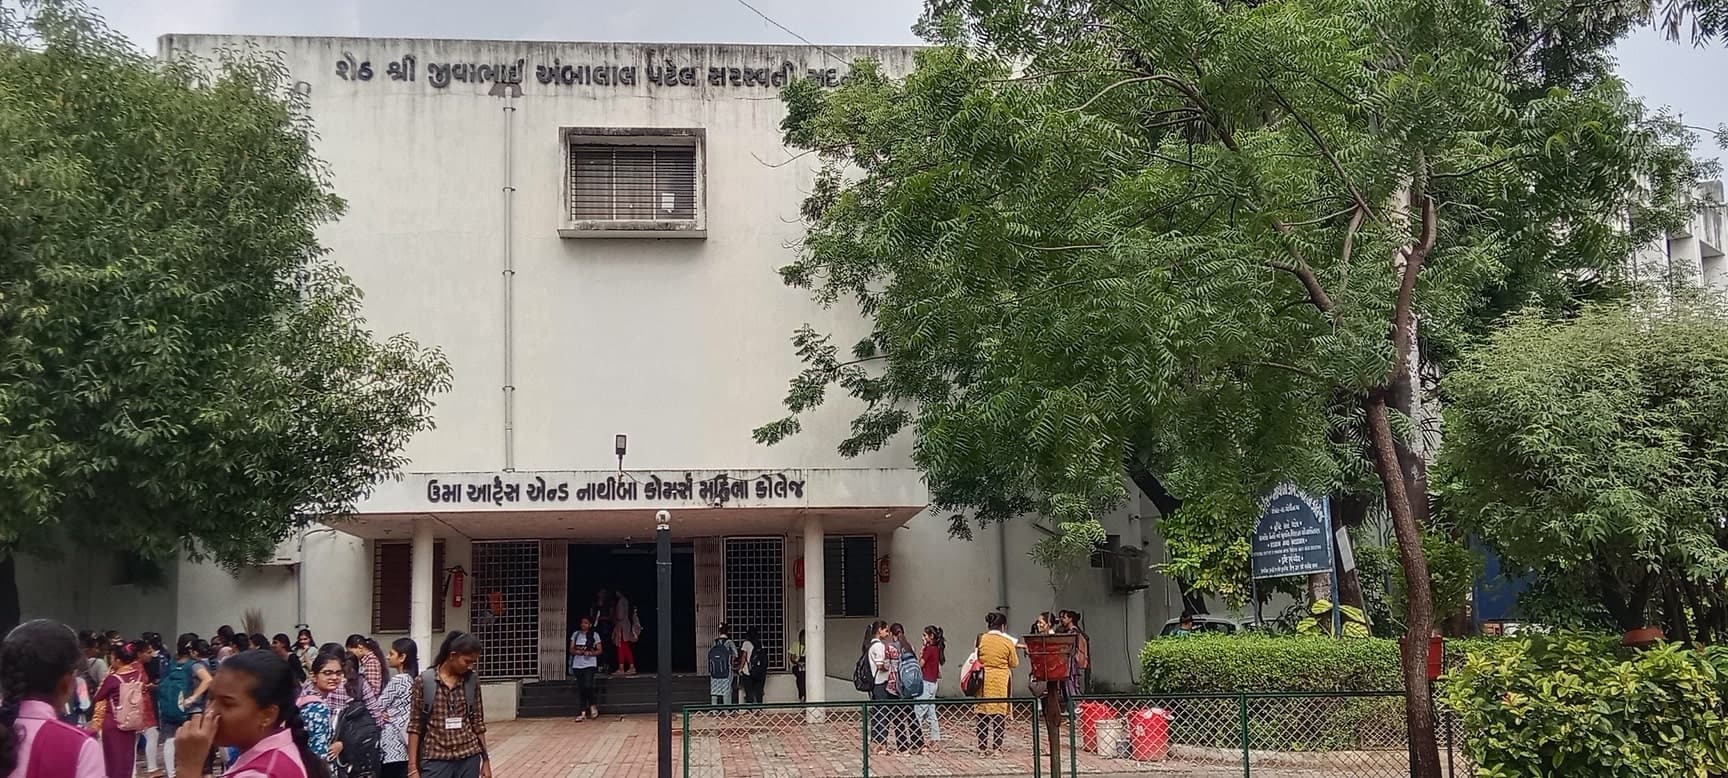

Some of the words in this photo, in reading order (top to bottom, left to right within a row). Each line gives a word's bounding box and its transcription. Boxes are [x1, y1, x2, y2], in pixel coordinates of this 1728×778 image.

[336, 52, 374, 82] શેઠ
[387, 54, 416, 82] શ્રી
[427, 59, 524, 88] જીવાભાઈ
[535, 59, 637, 86] અંબાલાલ
[647, 60, 696, 86] પટેલ
[707, 62, 793, 88] સરસ્વતી
[427, 479, 461, 503] ઉમા
[526, 476, 569, 502] એન્ડ
[576, 477, 636, 501] નાથીબા
[699, 474, 748, 502] મહિલા
[756, 473, 805, 499] કોલેજ
